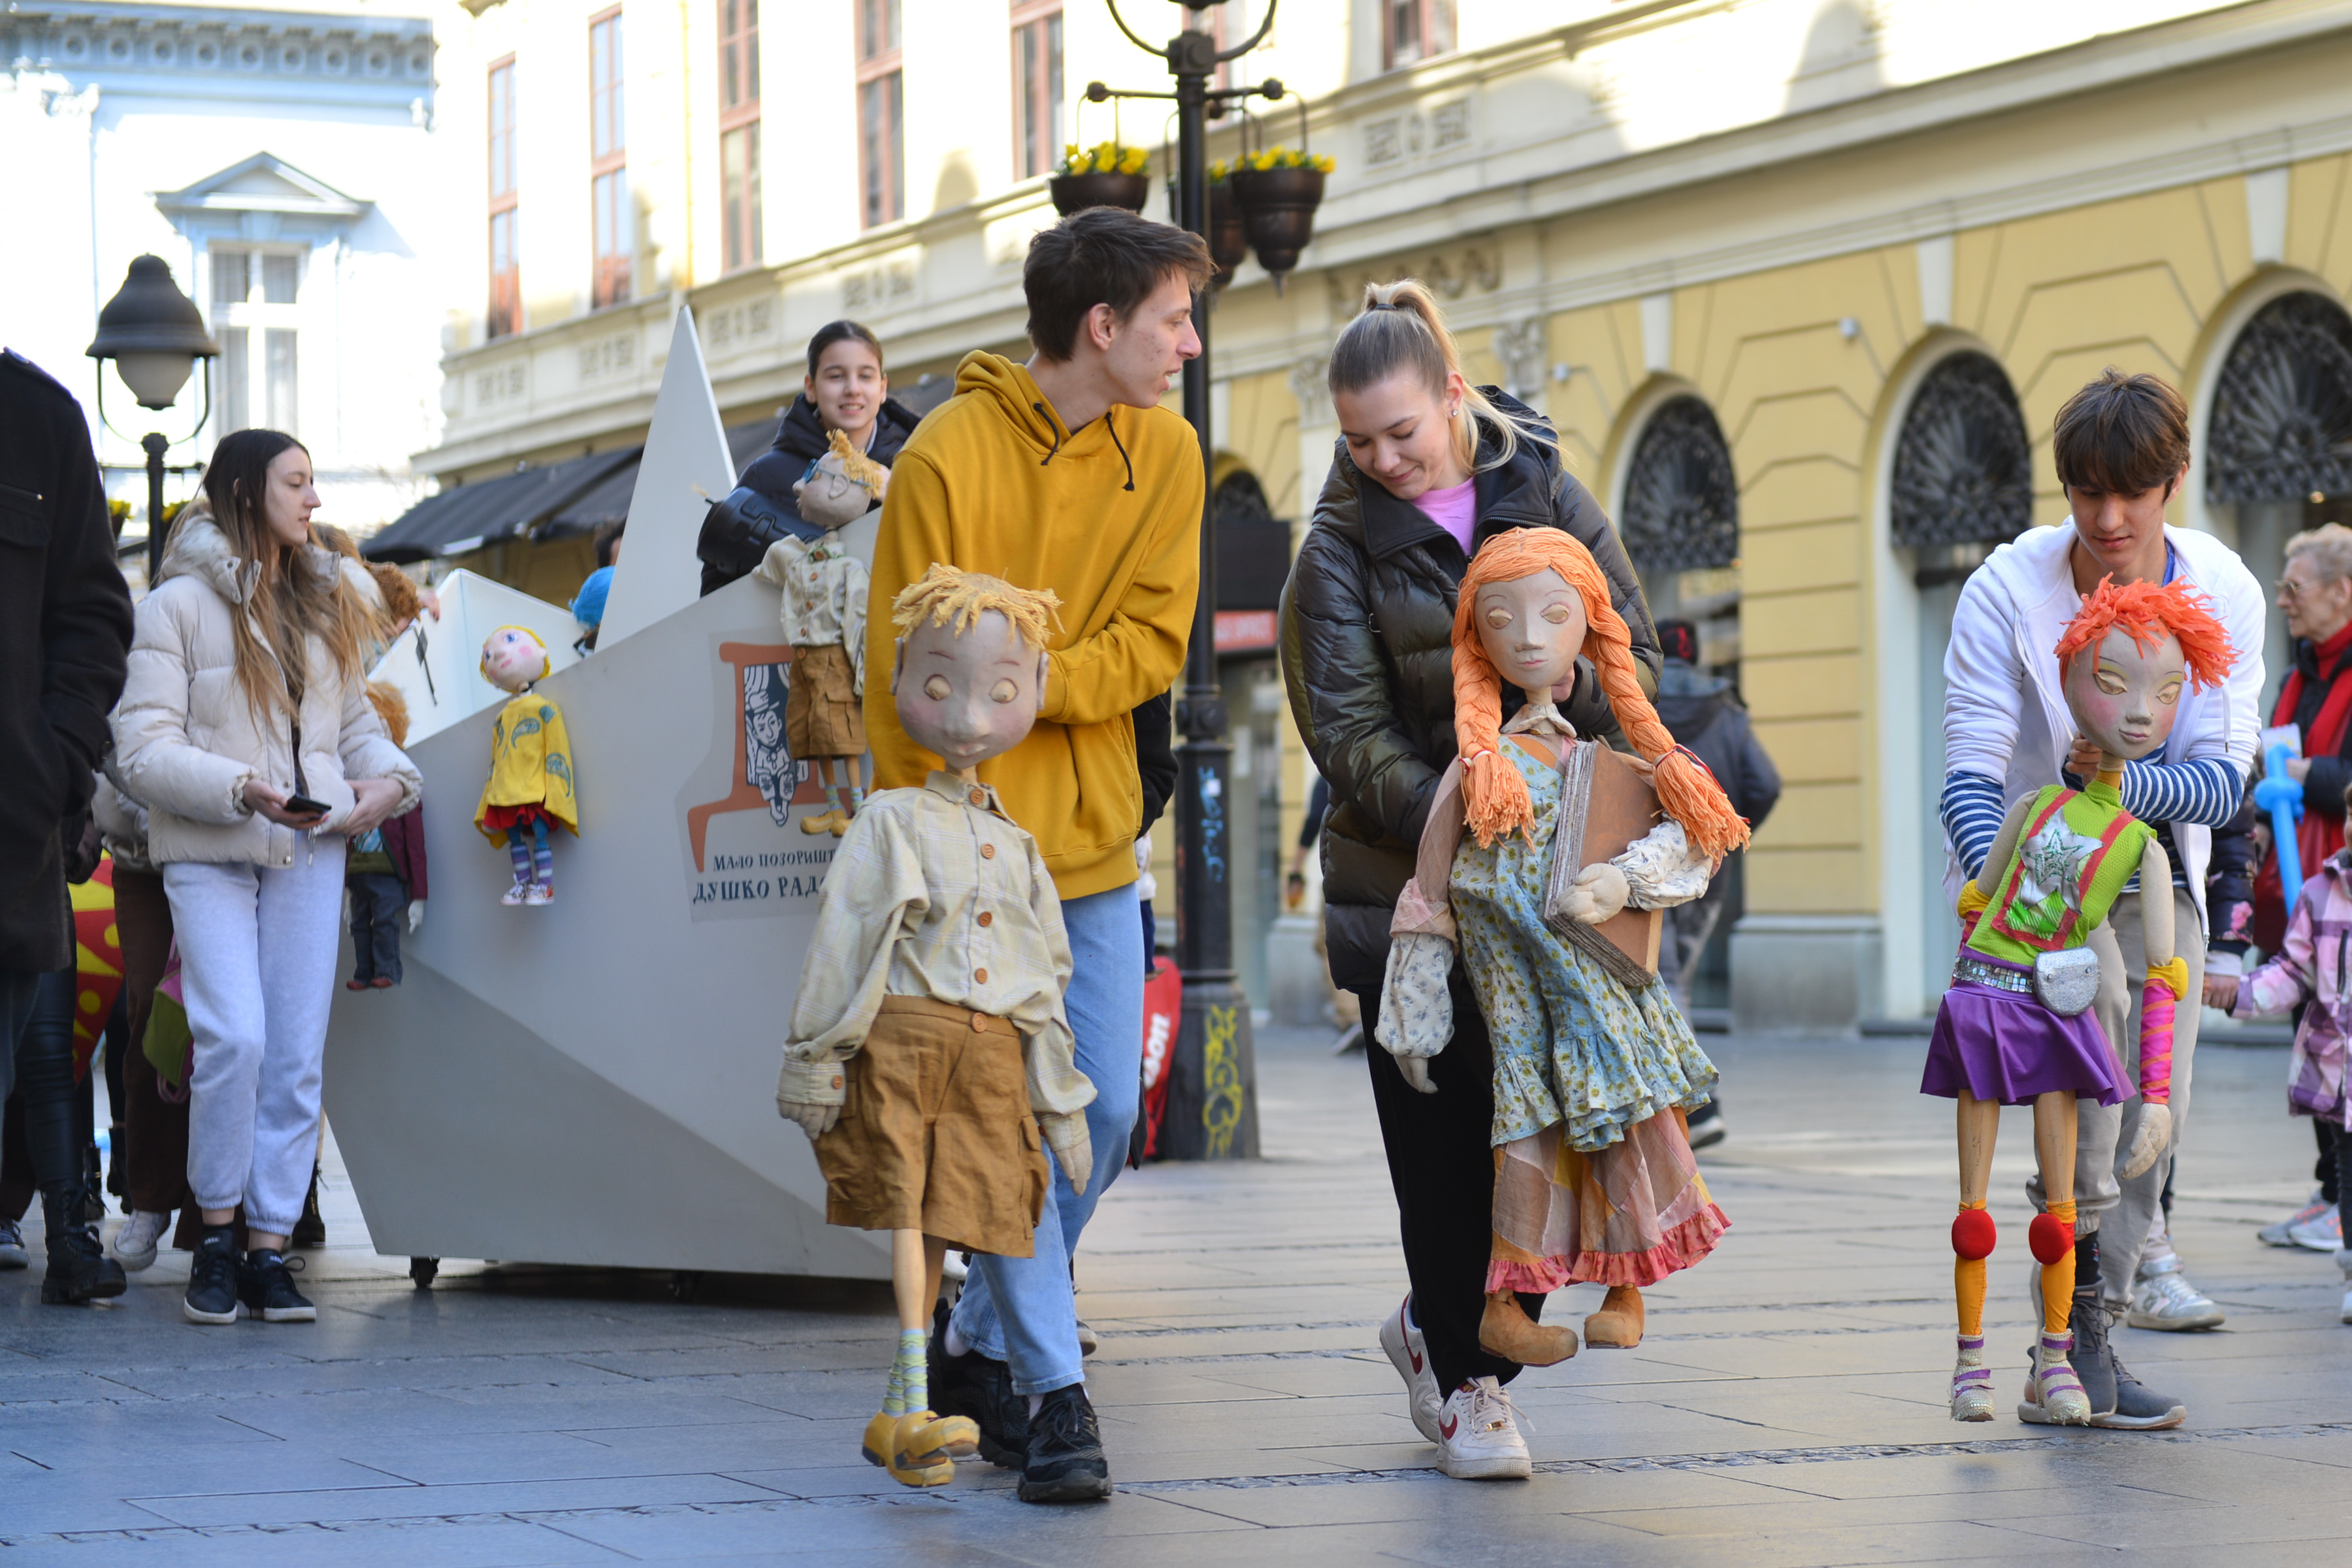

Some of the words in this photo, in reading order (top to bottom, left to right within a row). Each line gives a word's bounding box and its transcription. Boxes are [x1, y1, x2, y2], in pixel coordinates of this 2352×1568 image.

[713, 854, 754, 872] МАЛО
[693, 879, 770, 906] ДУШКО
[777, 874, 826, 898] РАД
